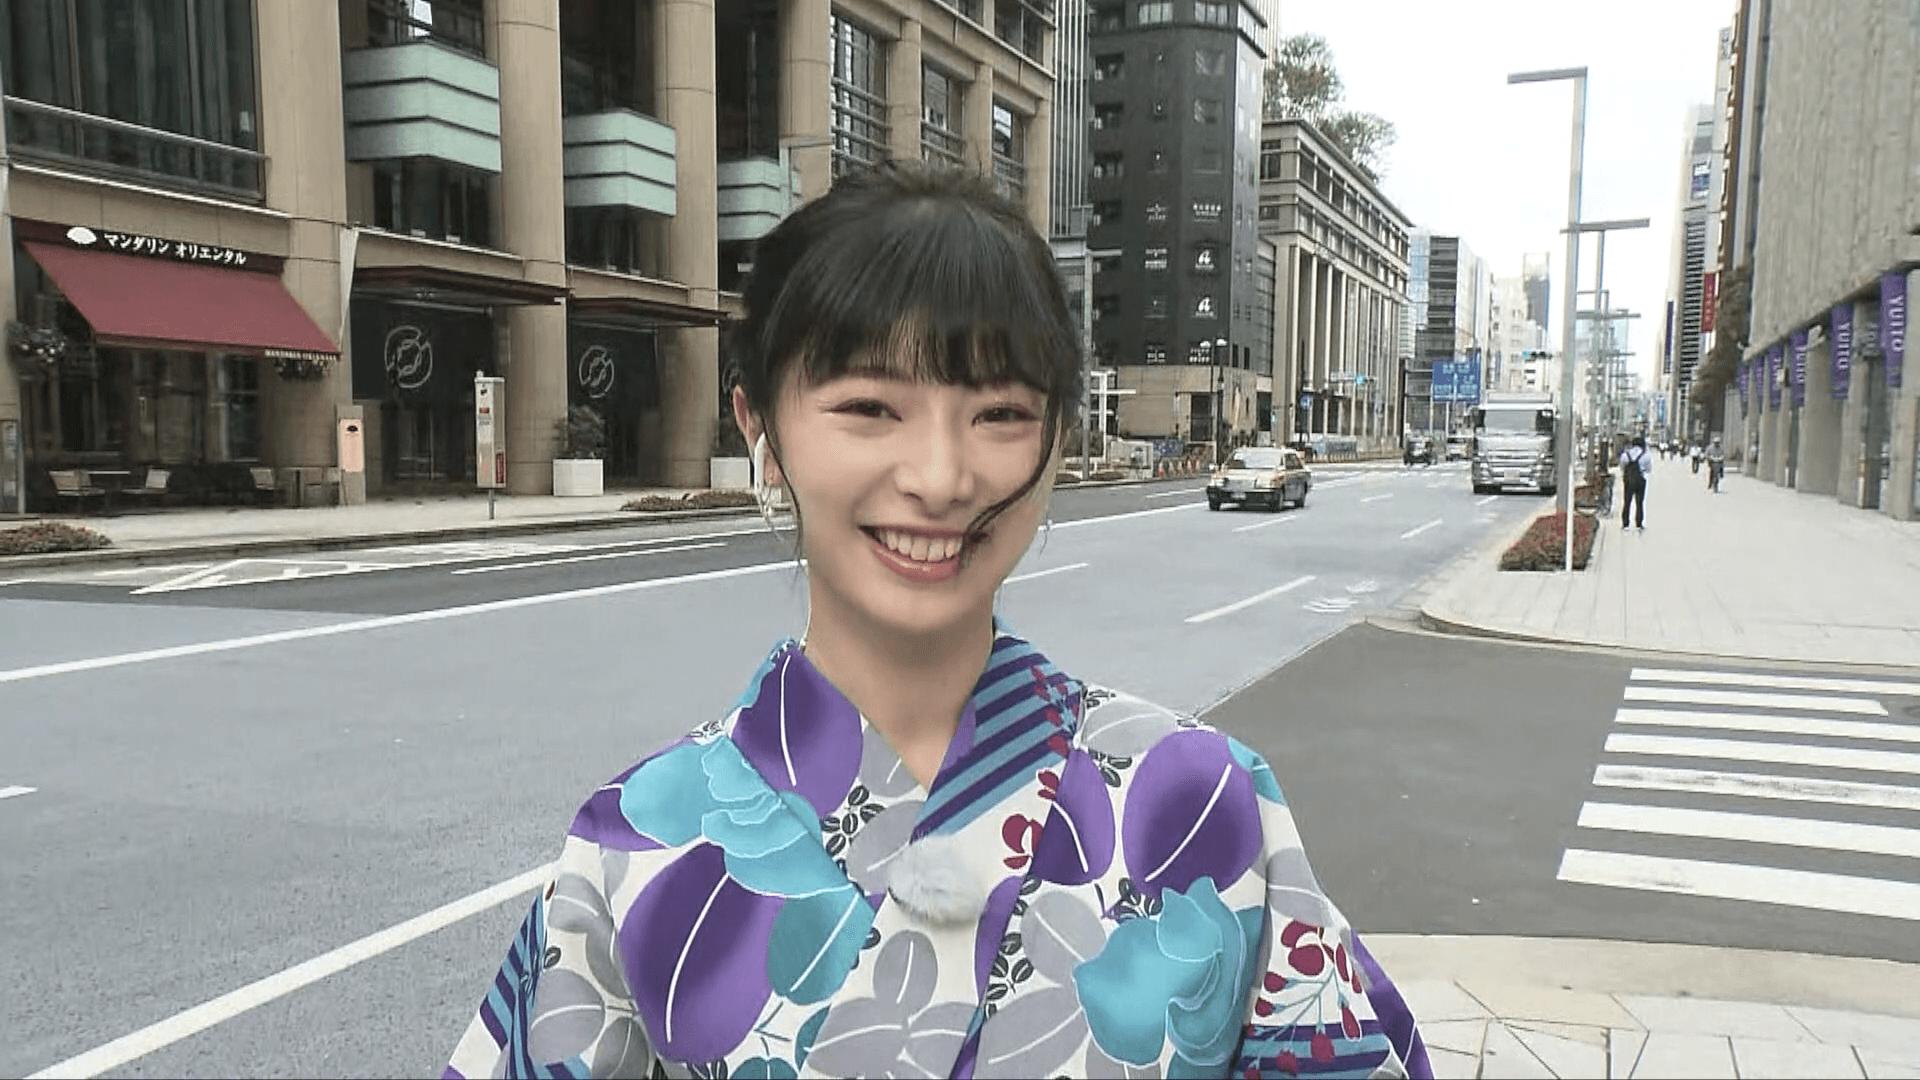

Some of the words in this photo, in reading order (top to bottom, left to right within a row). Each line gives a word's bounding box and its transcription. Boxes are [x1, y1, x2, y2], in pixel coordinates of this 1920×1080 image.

[103, 232, 170, 254] マンダリン
[174, 241, 247, 265] オリエンタル
